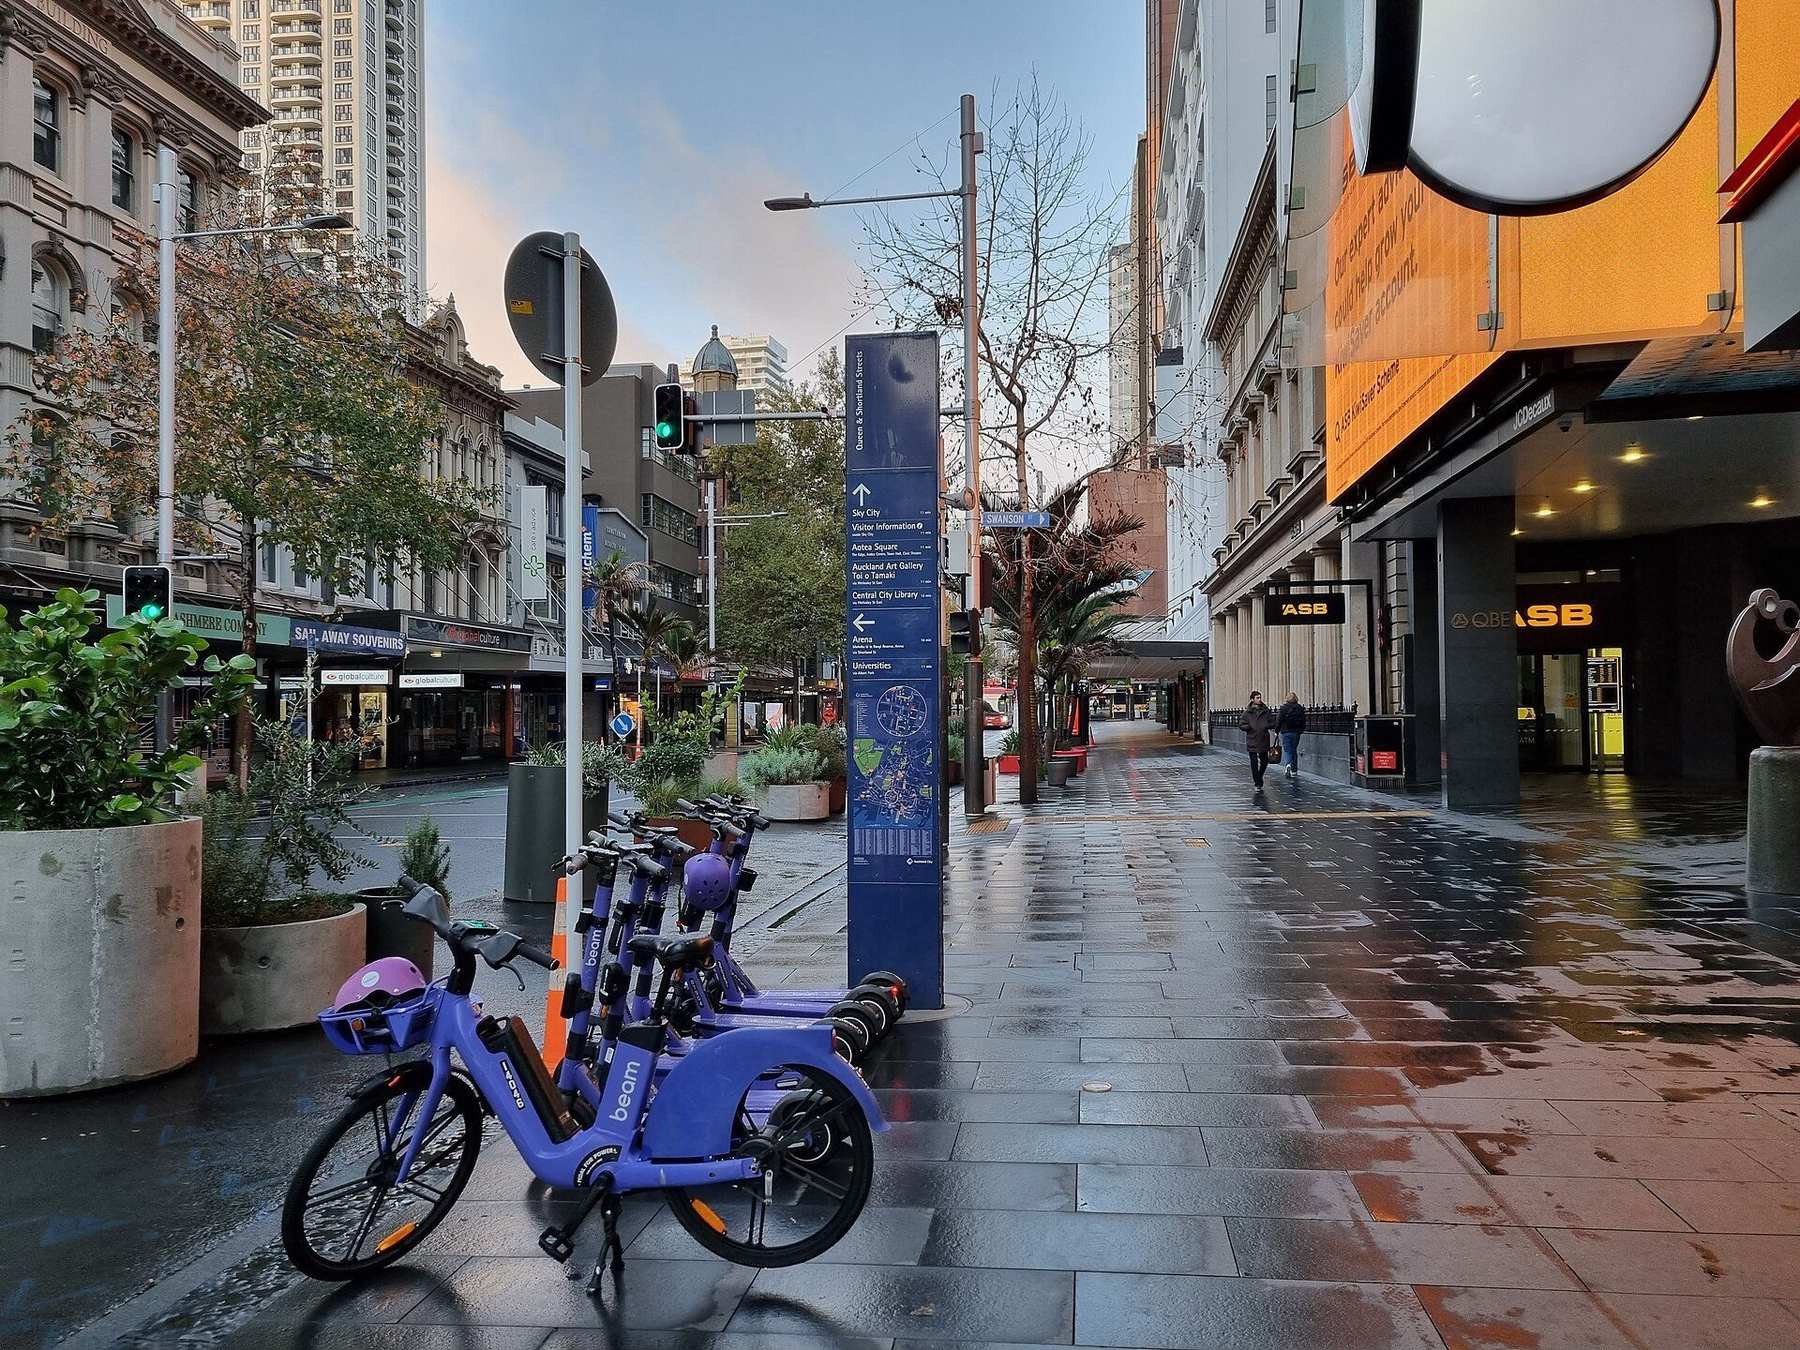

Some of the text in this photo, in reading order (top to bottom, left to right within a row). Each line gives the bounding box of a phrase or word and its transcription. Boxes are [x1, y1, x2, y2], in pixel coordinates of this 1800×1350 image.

[1334, 247, 1348, 287] Our
[1349, 193, 1375, 262] expert
[1334, 287, 1354, 331] could
[1355, 256, 1373, 301] help
[1375, 216, 1398, 280] grow
[1375, 244, 1418, 325] account.
[1377, 358, 1400, 394] Scheme
[855, 351, 863, 451] Queen & Shortland Streets
[1512, 393, 1551, 431] JCDecaux
[852, 508, 880, 518] Sky City
[986, 514, 1024, 524] SWANSON
[852, 522, 916, 531] Visitor Information
[852, 543, 898, 552] Aotea Square
[852, 561, 924, 571] Auckland Art Gallery
[852, 572, 862, 580] Toi
[871, 571, 895, 579] Tamaki
[852, 591, 877, 599] Central
[879, 591, 893, 600] City
[894, 591, 918, 600] Library
[1282, 603, 1328, 616] ASB
[1472, 611, 1511, 628] QBE
[321, 630, 350, 645] AWAY
[352, 633, 404, 650] SOUVENIRS
[852, 635, 873, 643] Arena
[852, 661, 892, 670] Universities
[338, 672, 385, 682] globalculture
[415, 676, 458, 685] globalculture
[585, 929, 603, 967] beam
[501, 1061, 525, 1109] 14046
[609, 1061, 641, 1122] beam
